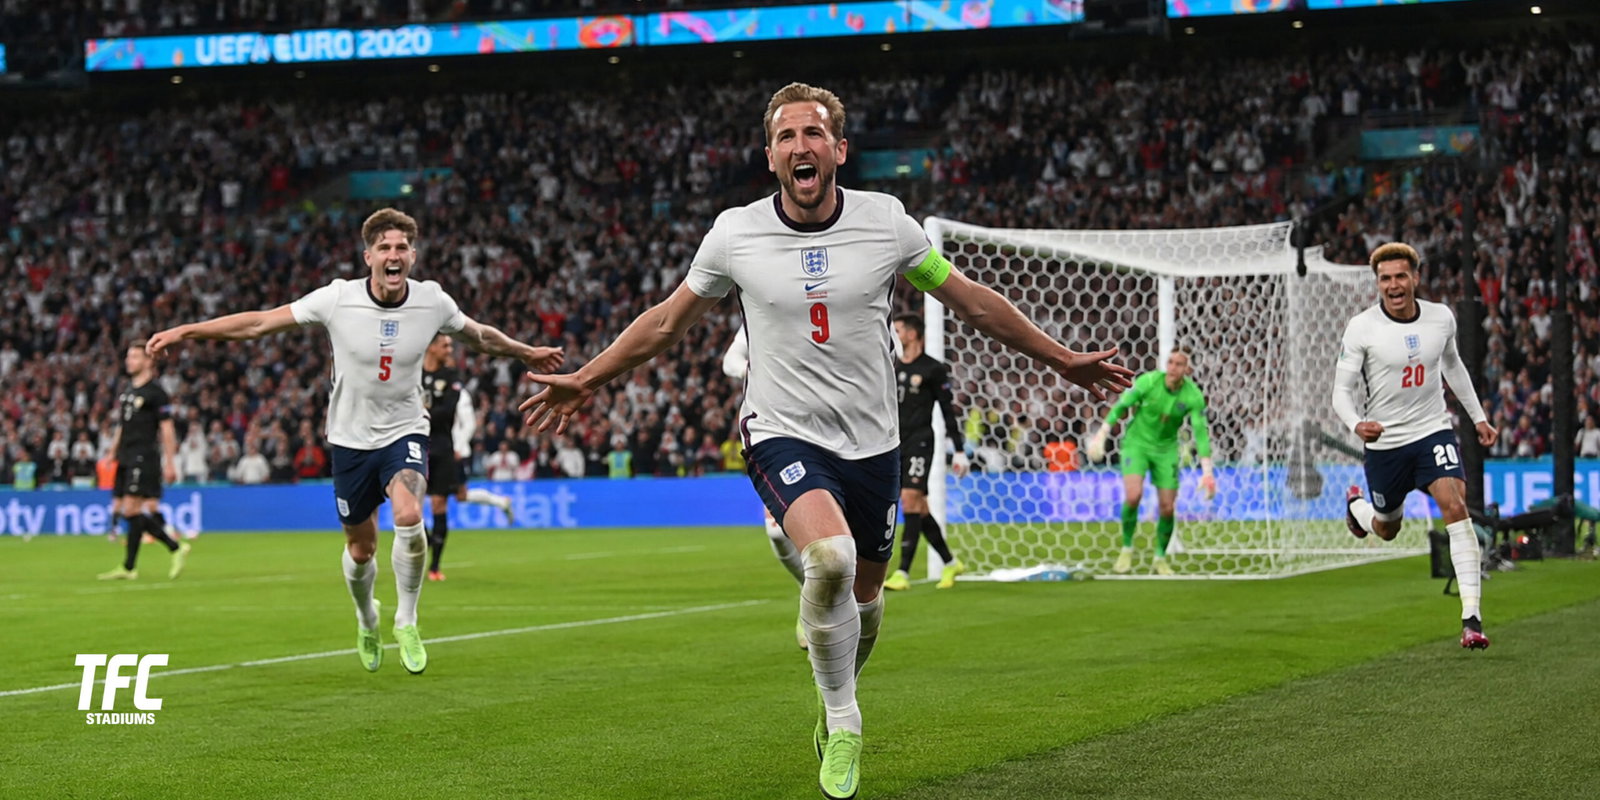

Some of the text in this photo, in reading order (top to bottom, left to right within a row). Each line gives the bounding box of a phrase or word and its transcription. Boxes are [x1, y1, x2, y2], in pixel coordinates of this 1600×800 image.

[196, 26, 433, 65] UEFA EURO 2020
[810, 302, 830, 343] 9
[378, 356, 392, 381] 5
[1401, 364, 1425, 388] 20
[908, 456, 926, 477] 13
[1433, 444, 1459, 467] 20
[884, 503, 896, 540] 9
